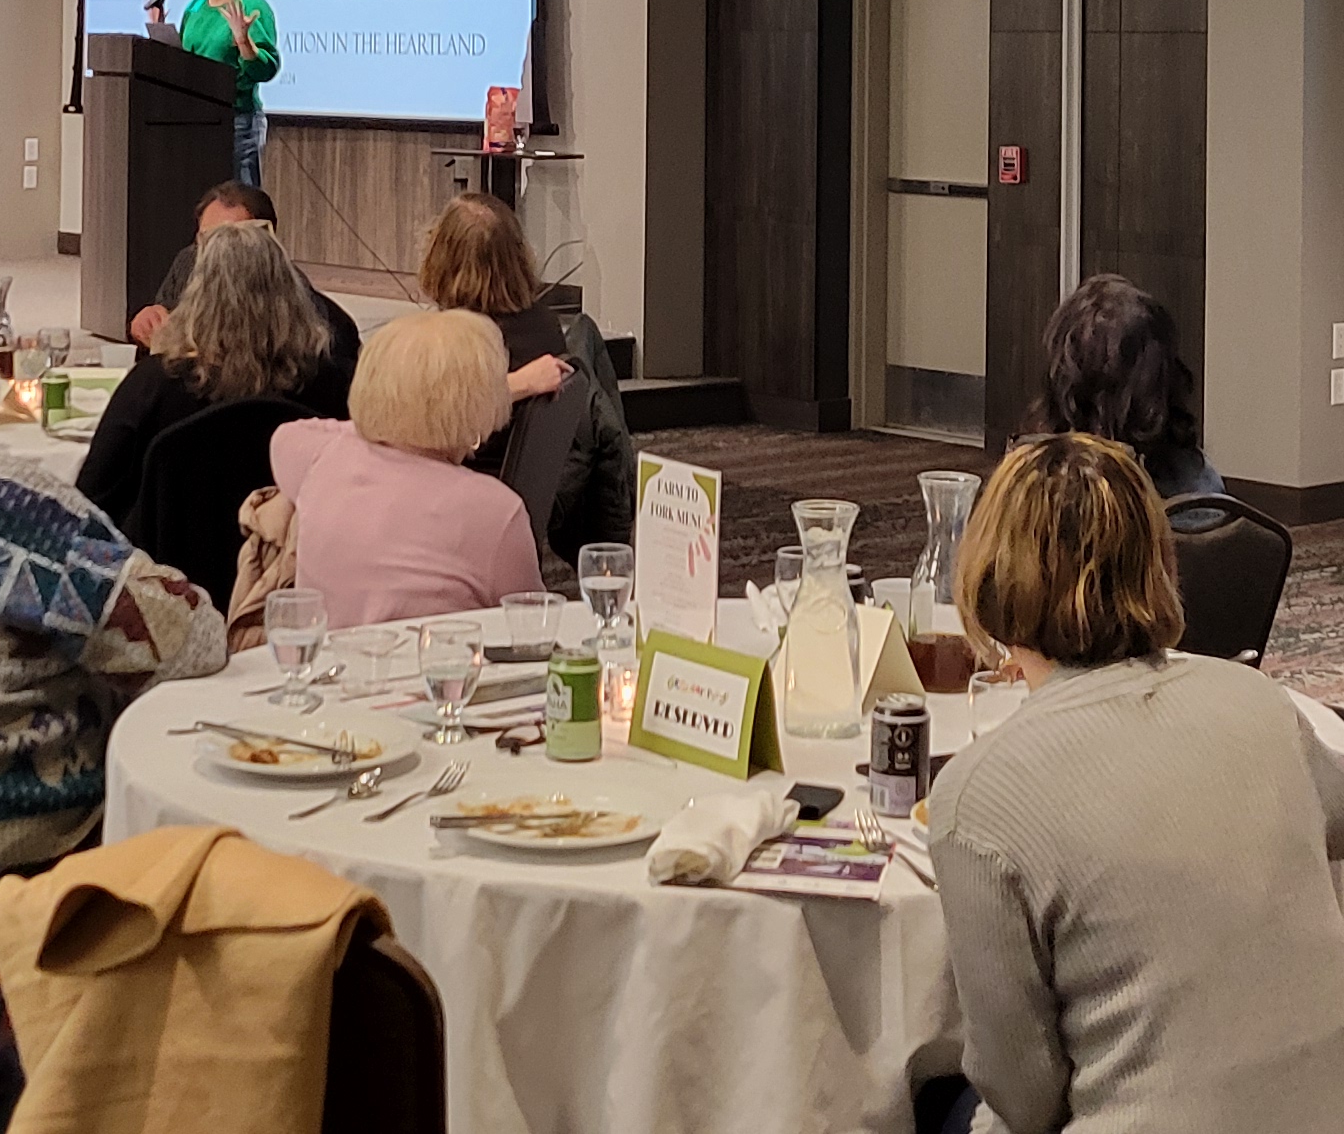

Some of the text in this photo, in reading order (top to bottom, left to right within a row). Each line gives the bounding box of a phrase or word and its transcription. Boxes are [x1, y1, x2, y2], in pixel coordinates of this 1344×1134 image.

[332, 32, 348, 54] IN
[355, 32, 381, 55] THE
[386, 32, 486, 57] HEARTLAND
[650, 499, 675, 524] FORK
[653, 699, 734, 740] RESERVED
